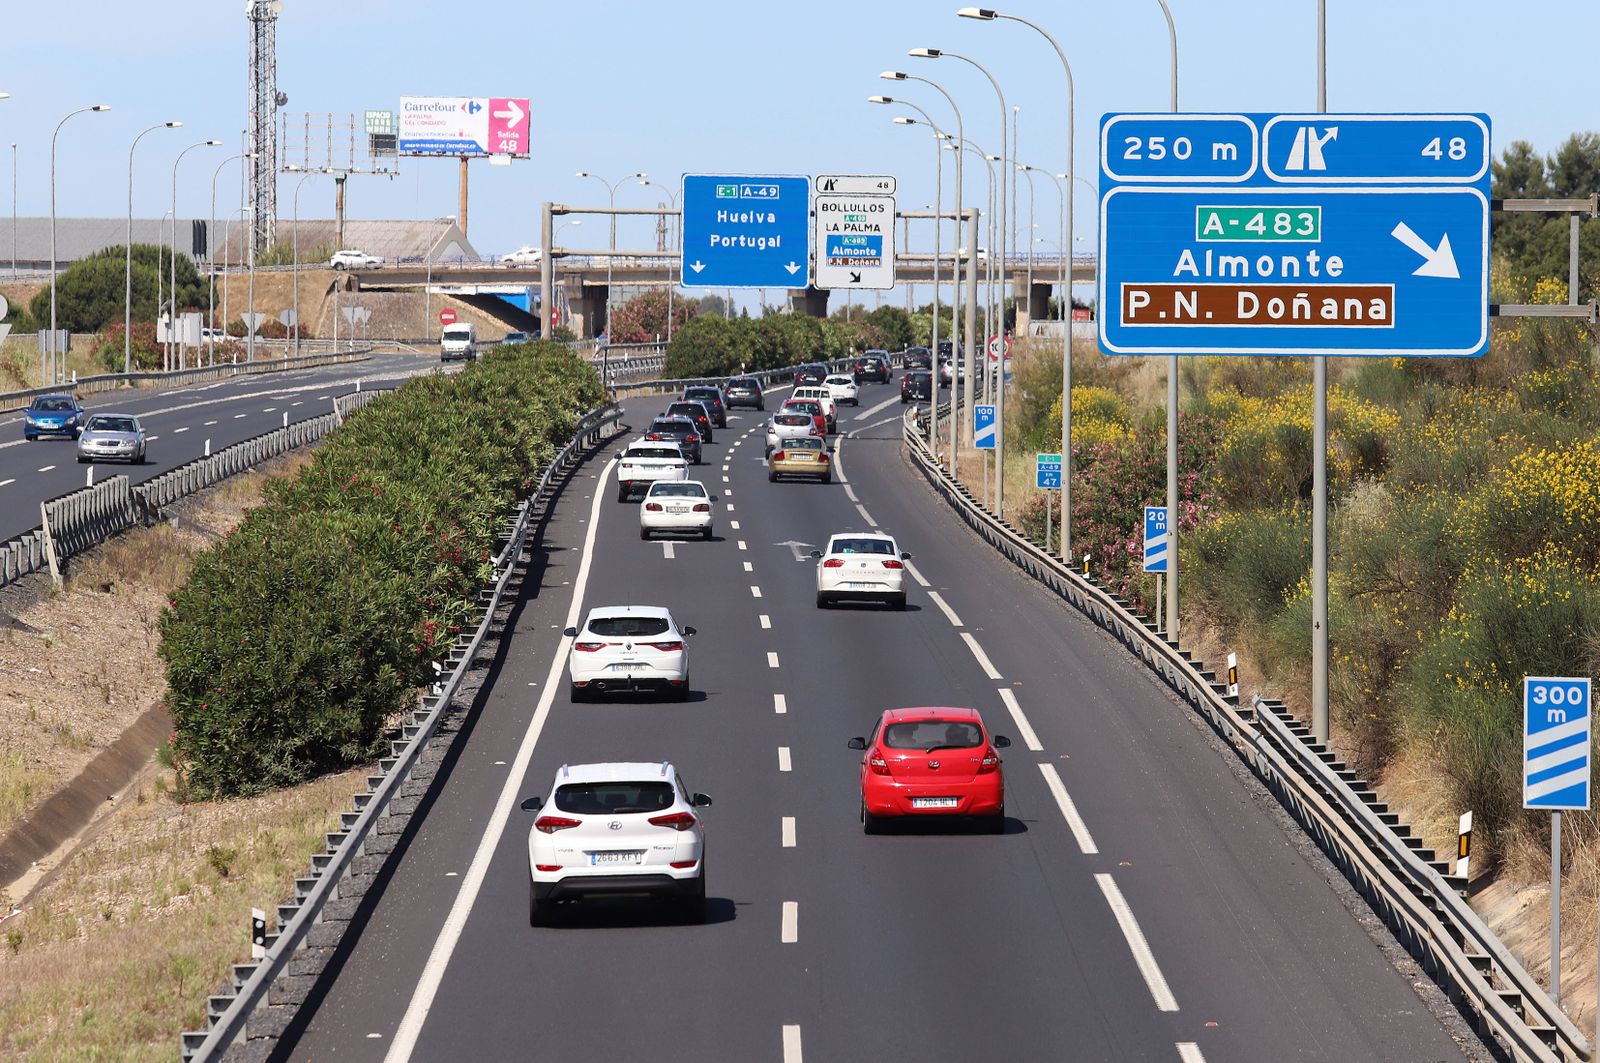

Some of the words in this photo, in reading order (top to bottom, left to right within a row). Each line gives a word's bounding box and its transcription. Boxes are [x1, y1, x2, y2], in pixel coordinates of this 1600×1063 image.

[405, 102, 456, 112] Carrefour
[499, 140, 518, 152] 48
[1123, 137, 1192, 160] 250
[1212, 142, 1237, 160] m
[1421, 137, 1467, 160] 48
[718, 187, 736, 196] E-1
[744, 187, 777, 196] A-49
[822, 203, 885, 212] BOLLULLOS
[717, 210, 776, 224] Huelva
[826, 224, 840, 232] LA
[844, 224, 881, 232] PALMA
[1203, 212, 1315, 236] A-483
[710, 234, 781, 250] Portugal
[832, 246, 877, 256] Almonte
[1173, 249, 1344, 278] Almonte
[1128, 291, 1213, 319] P.N.
[1238, 292, 1386, 320] Doñana
[1148, 511, 1168, 521] 20
[1533, 686, 1583, 705] 300
[1548, 708, 1566, 722] m
[598, 853, 619, 862] 2663
